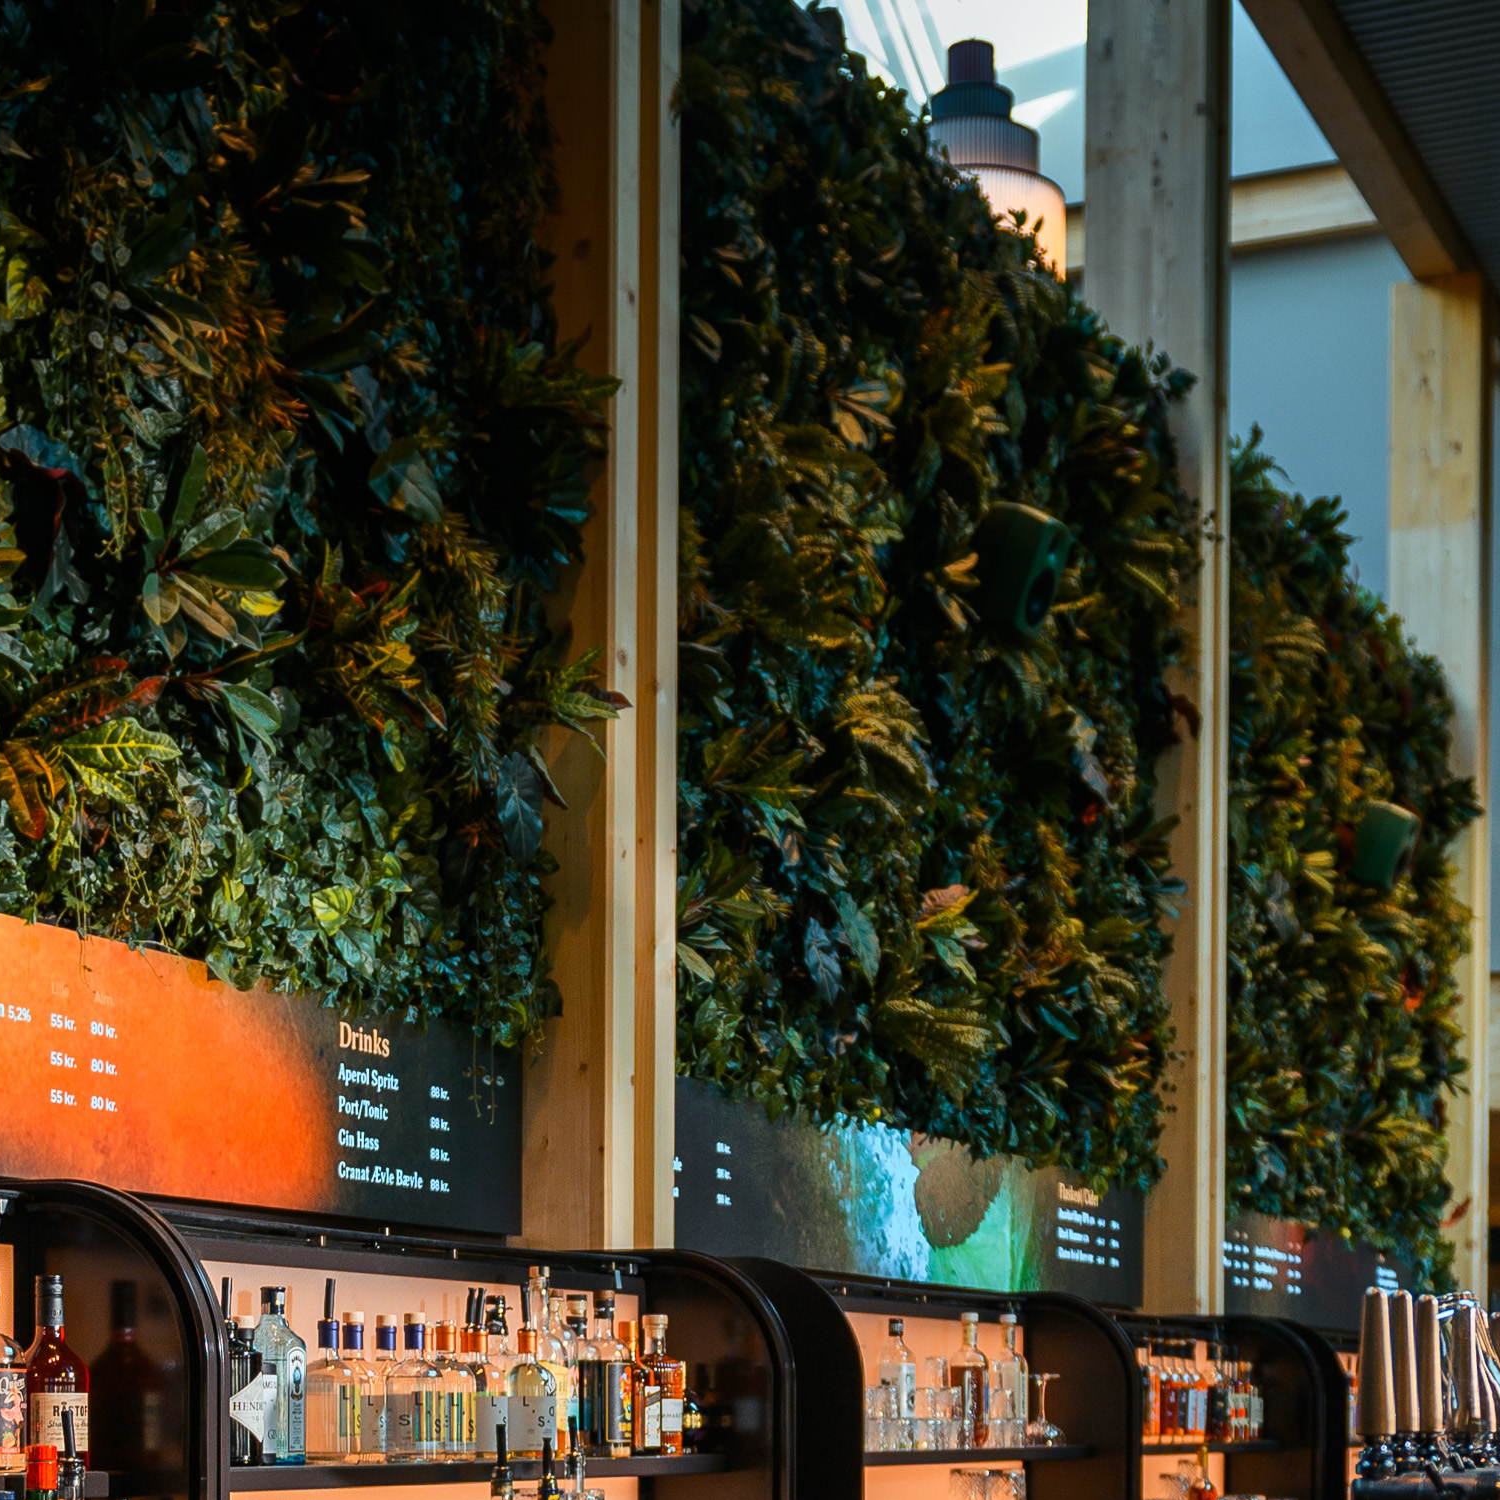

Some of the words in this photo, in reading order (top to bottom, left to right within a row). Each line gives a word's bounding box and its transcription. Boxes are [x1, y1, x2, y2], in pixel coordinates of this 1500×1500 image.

[8, 1004, 31, 1022] 5,2%
[51, 1013, 62, 1028] 55
[64, 1016, 77, 1031] kr.
[91, 1021, 103, 1036] 80
[105, 1023, 117, 1038] kr.
[339, 1021, 390, 1058] Drinks
[51, 1051, 62, 1066] 55
[64, 1053, 77, 1069] kr.
[91, 1058, 104, 1073] 80
[105, 1060, 117, 1076] kr.
[338, 1062, 370, 1088] Aperol
[371, 1069, 399, 1093] Spritz
[50, 1088, 62, 1104] 55
[64, 1091, 77, 1107] kr.
[91, 1095, 104, 1111] 80
[105, 1097, 117, 1112] kr.
[338, 1095, 388, 1121] Port/Tonic
[357, 1131, 379, 1151] Hass
[338, 1160, 370, 1184] Granat
